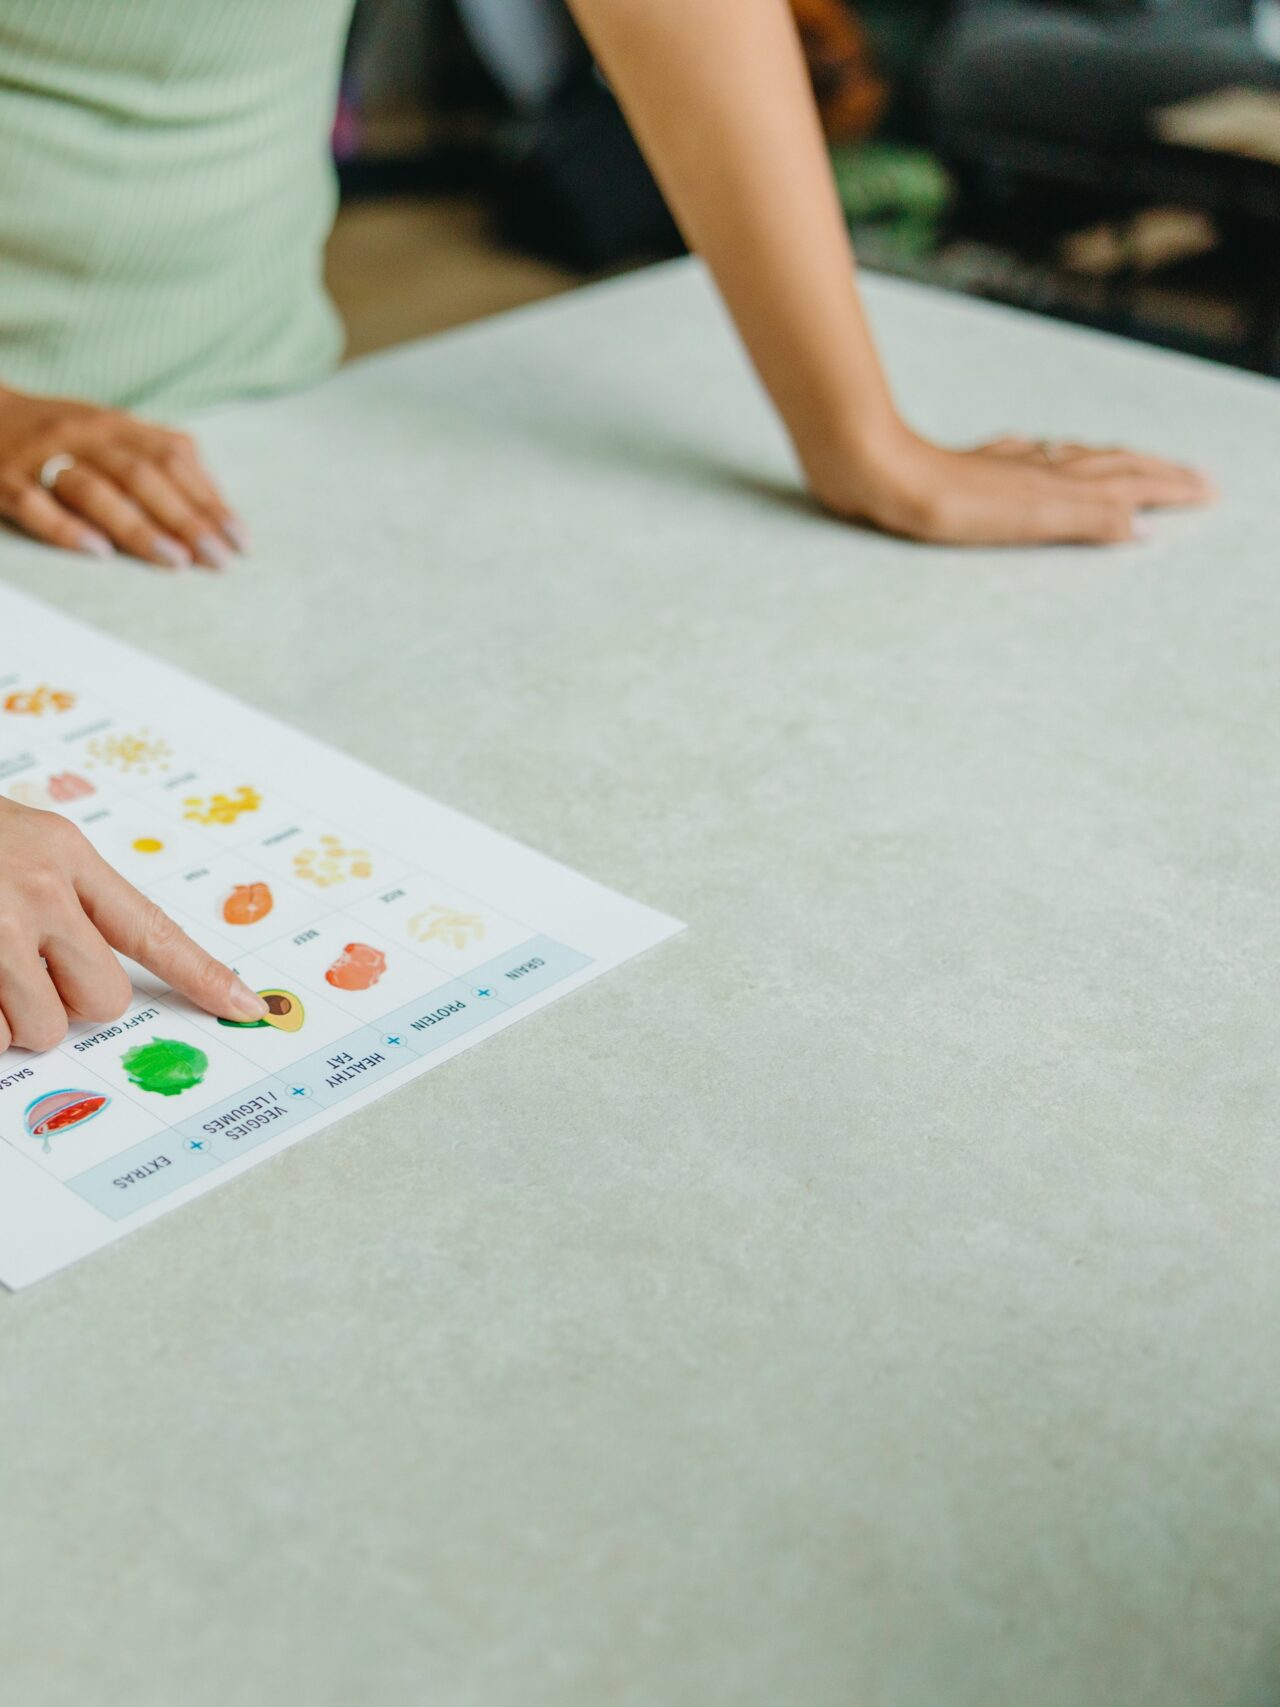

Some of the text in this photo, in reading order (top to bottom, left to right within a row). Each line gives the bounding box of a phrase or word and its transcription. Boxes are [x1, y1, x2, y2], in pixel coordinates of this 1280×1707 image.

[293, 929, 320, 946] BEEF
[505, 957, 546, 981] GRAIN
[73, 1008, 160, 1052] LEAFY GREANS
[410, 1000, 467, 1031] PROTEIN
[325, 1052, 386, 1088] HEALTHY
[326, 1052, 354, 1070] FAT
[202, 1096, 271, 1135] LEGUMES
[225, 1106, 288, 1141] VEGGIES
[113, 1155, 172, 1189] EXTRAS
